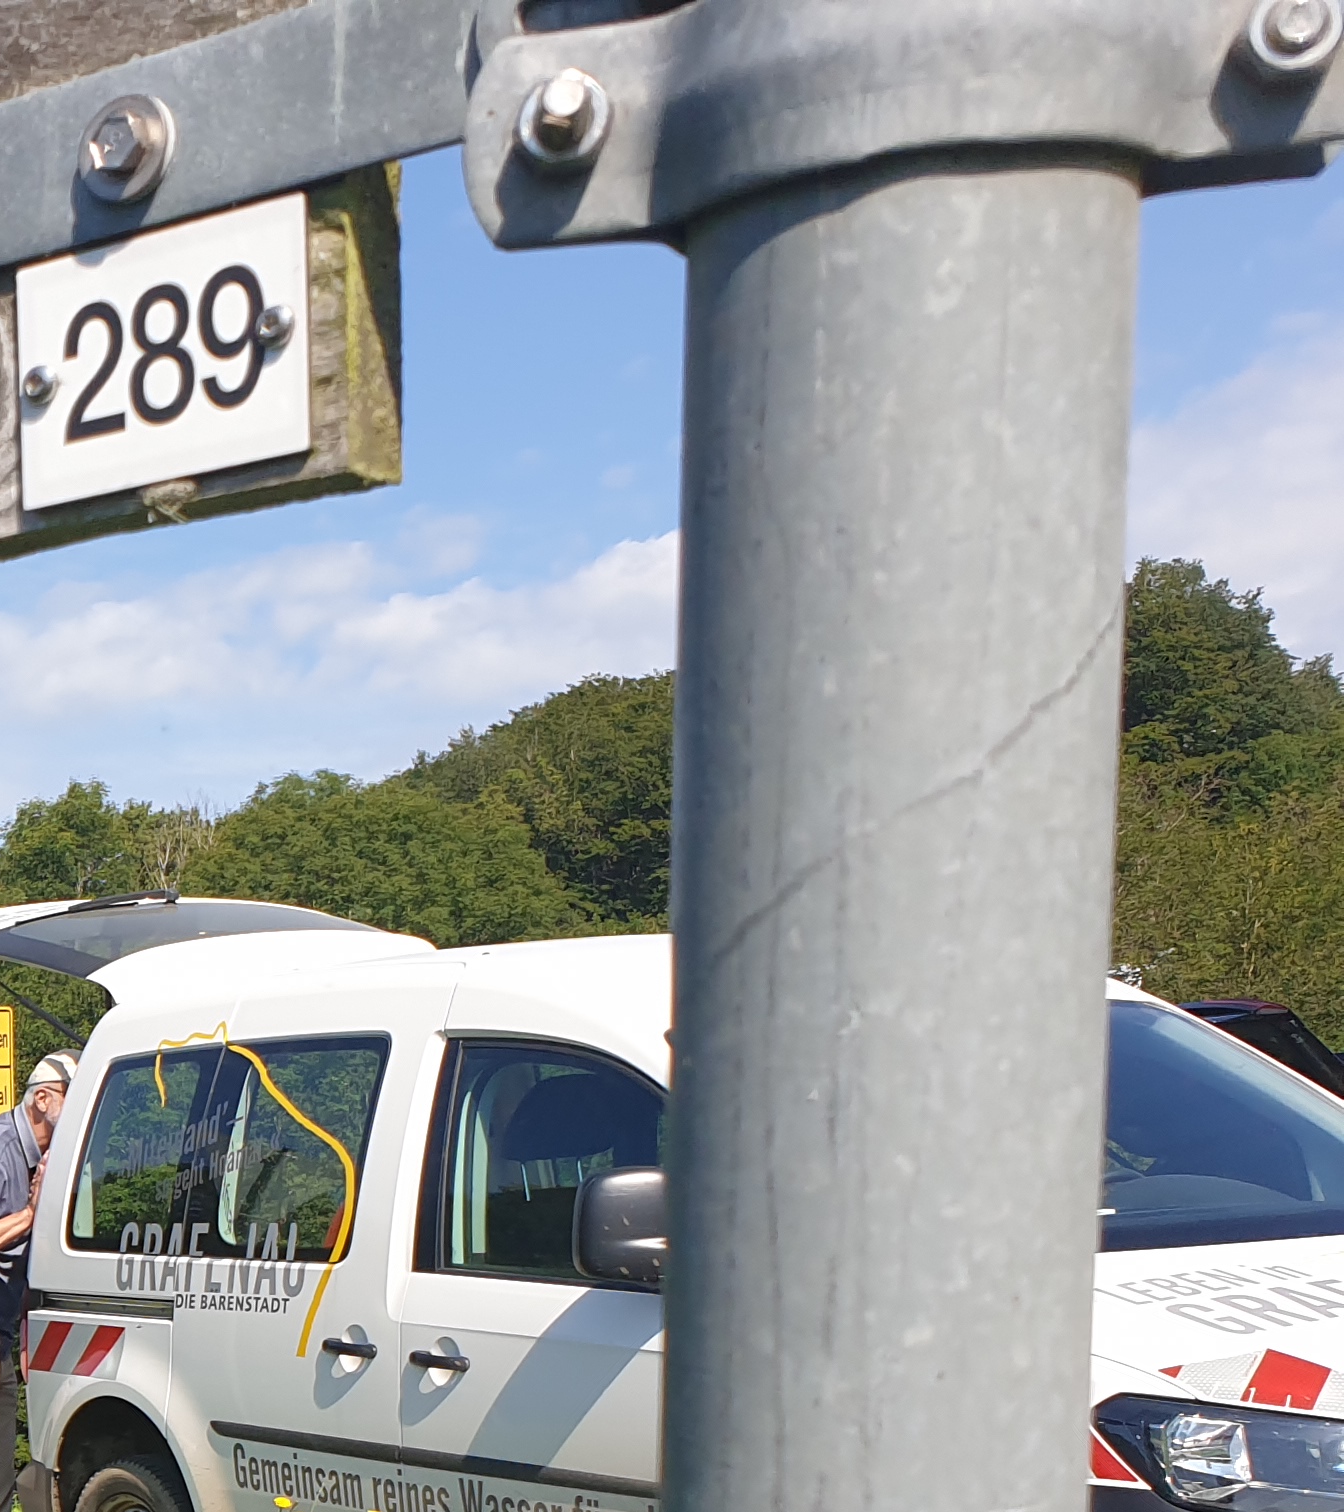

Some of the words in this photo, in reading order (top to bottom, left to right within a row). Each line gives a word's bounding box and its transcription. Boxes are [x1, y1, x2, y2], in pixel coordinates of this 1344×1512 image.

[62, 264, 265, 446] 289
[175, 1293, 196, 1310] DIE
[1093, 1268, 1260, 1305] LEBEN
[1237, 1264, 1313, 1281] in
[233, 1442, 364, 1510] Gemeinsam
